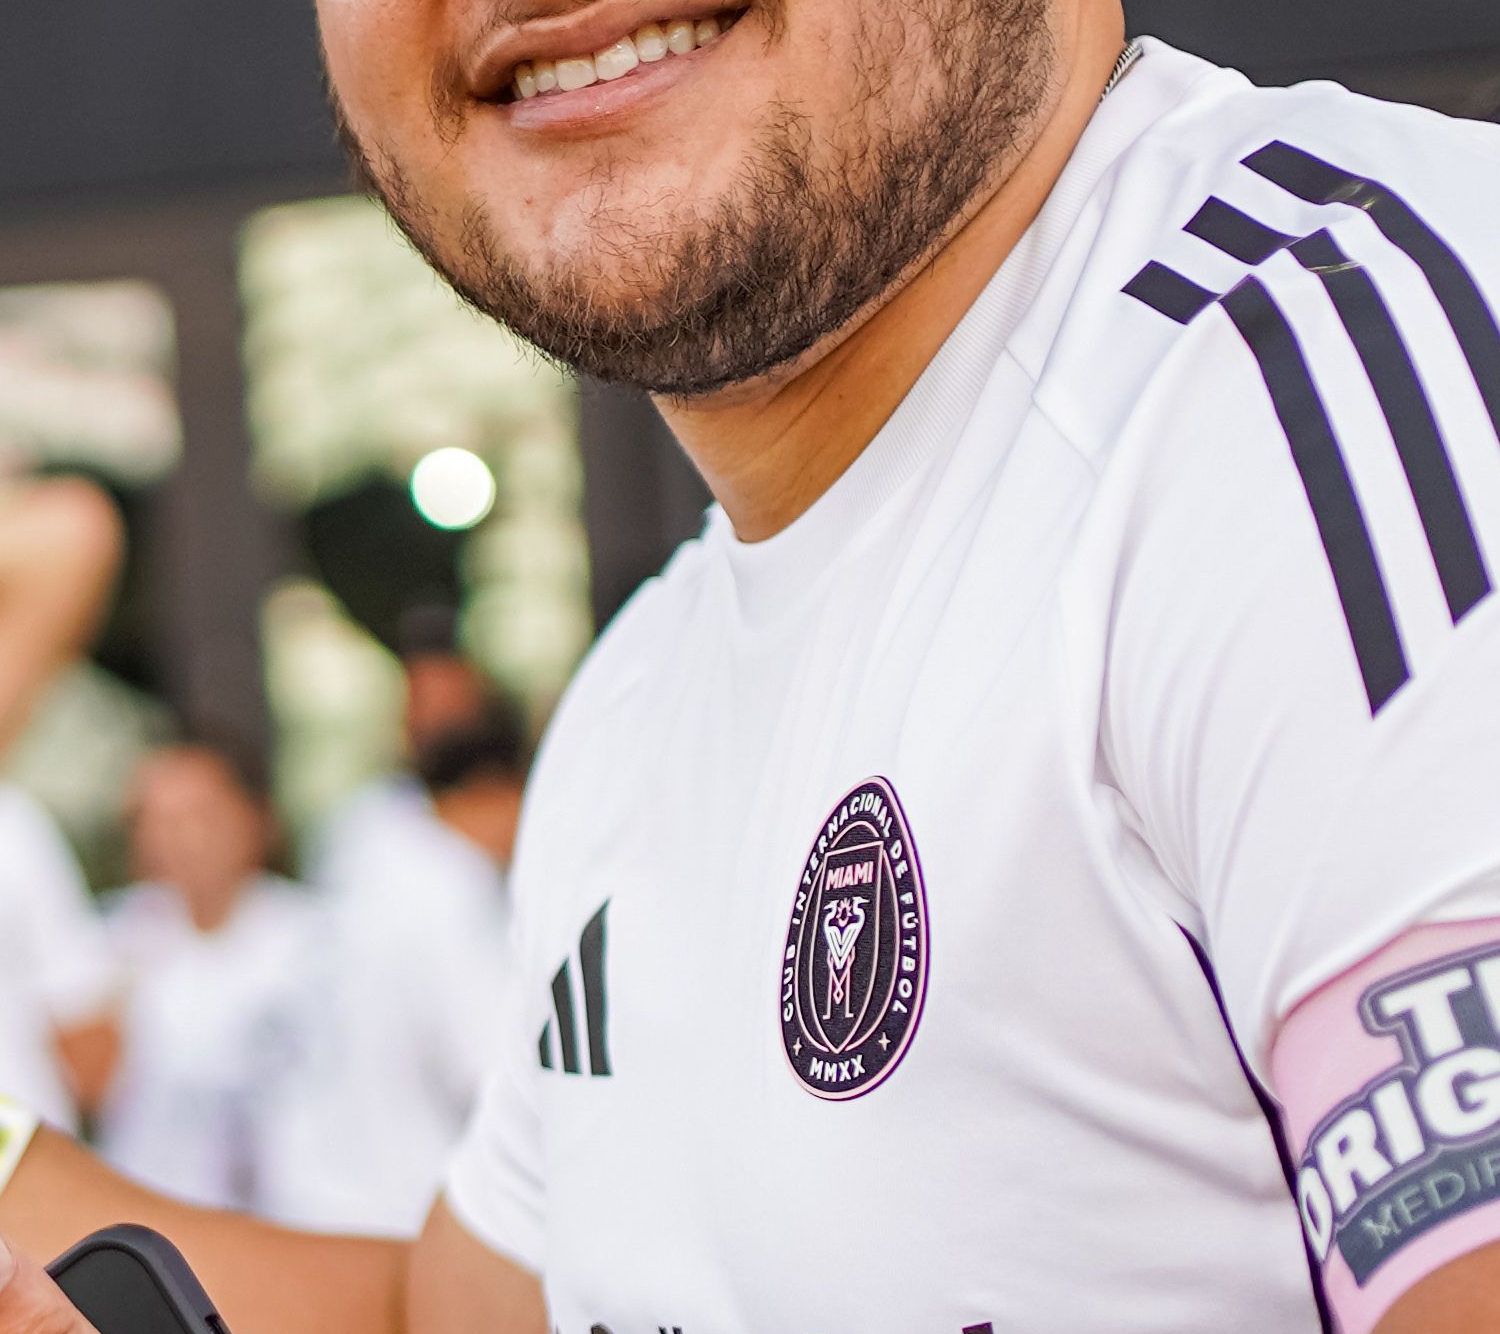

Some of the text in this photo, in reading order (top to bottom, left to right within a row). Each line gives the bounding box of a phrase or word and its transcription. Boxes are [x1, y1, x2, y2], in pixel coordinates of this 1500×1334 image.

[825, 860, 875, 891] MIAMI
[783, 944, 797, 1022] CLUB
[791, 792, 893, 925] INTERNACIONAL
[890, 839, 909, 879] DE
[808, 1054, 867, 1083] MMXX
